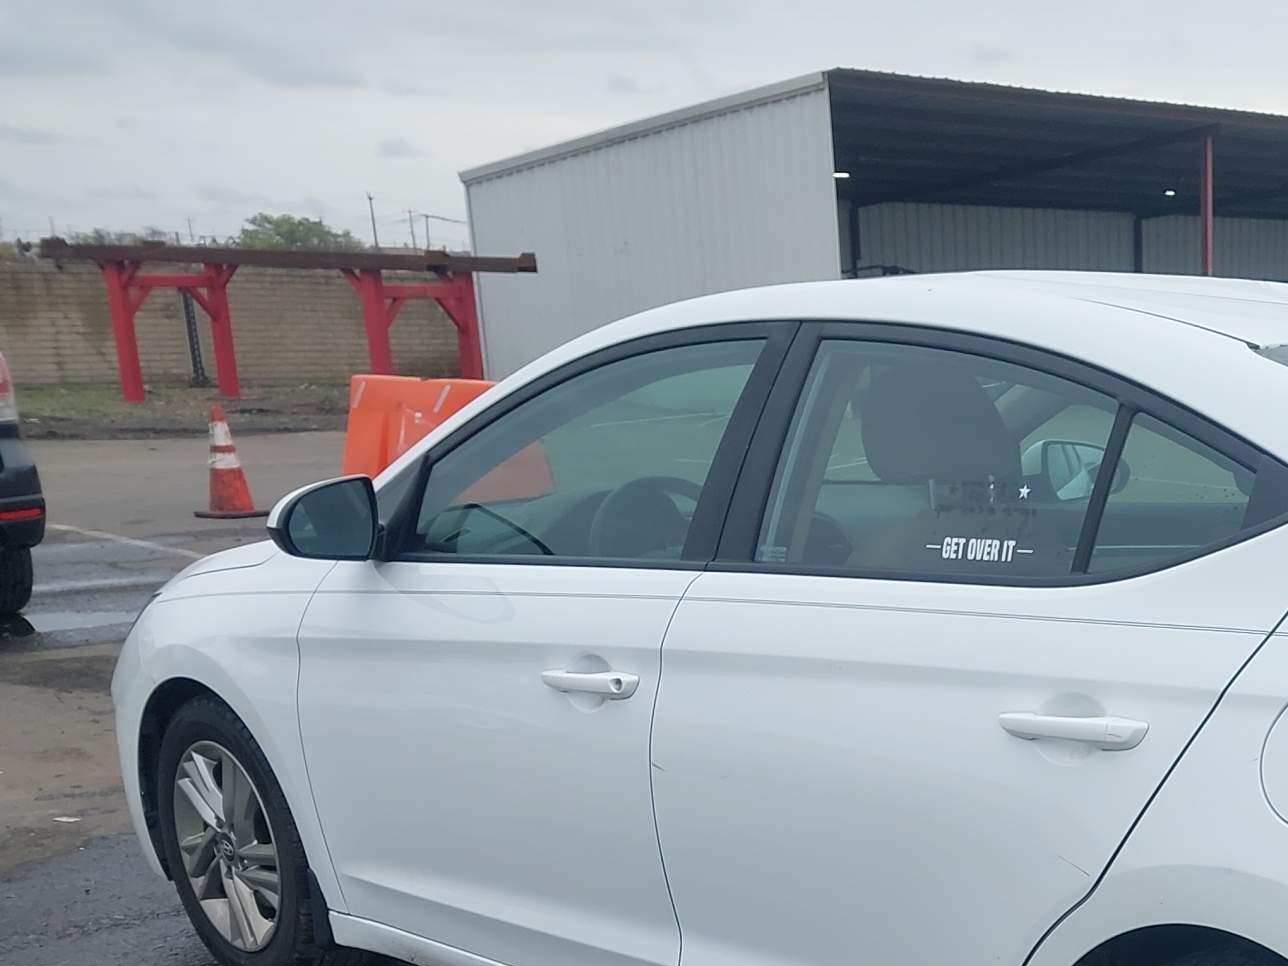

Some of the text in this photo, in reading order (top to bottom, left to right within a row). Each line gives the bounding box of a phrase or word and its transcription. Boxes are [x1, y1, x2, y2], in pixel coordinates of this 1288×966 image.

[942, 537, 1017, 562] GET OVER IT
